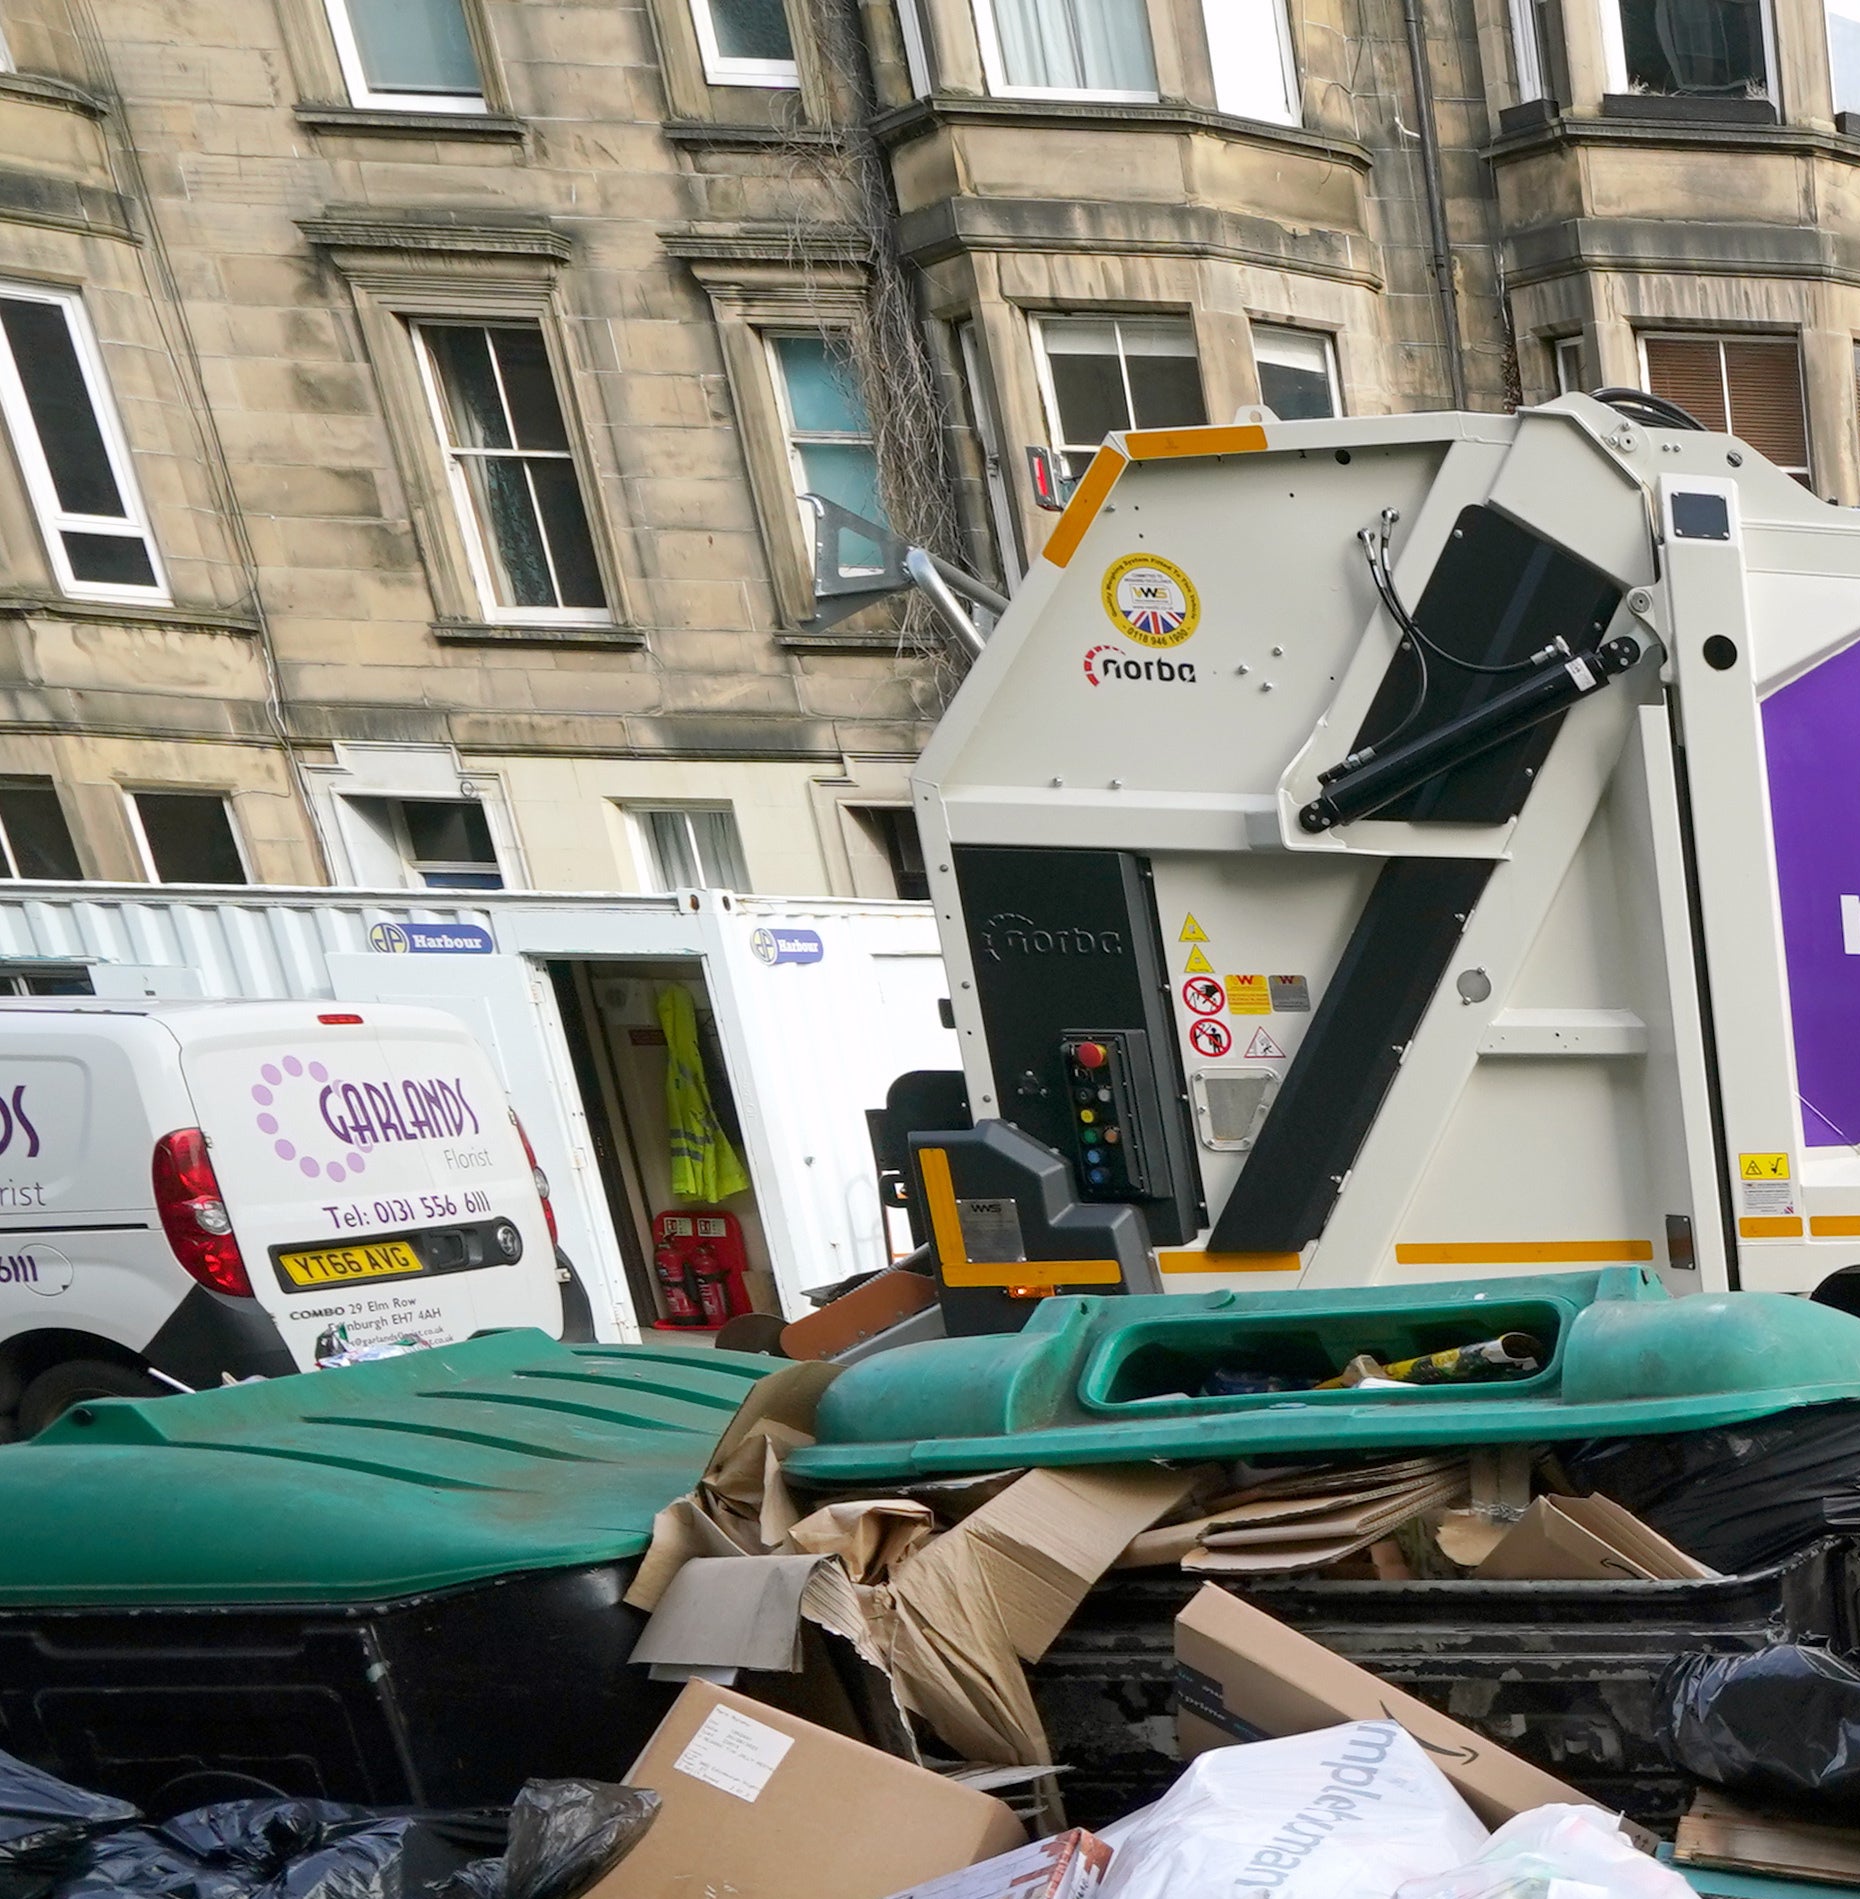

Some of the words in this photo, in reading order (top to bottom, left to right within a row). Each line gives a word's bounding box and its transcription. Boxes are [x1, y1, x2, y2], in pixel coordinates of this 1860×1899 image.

[1102, 657, 1196, 683] norba
[411, 933, 483, 950] Harbour
[777, 938, 818, 954] Harbour
[318, 1077, 481, 1145] GARLANDS
[443, 1147, 494, 1170] Florist
[322, 1203, 371, 1229] Tel:
[375, 1197, 416, 1224] 0131
[424, 1194, 458, 1218] 556
[465, 1190, 492, 1214] 6111
[293, 1253, 363, 1280] YT66
[369, 1245, 411, 1273] AVG
[289, 1307, 345, 1321] COMBO
[349, 1303, 363, 1315] 29
[368, 1301, 390, 1312] Elm
[392, 1297, 417, 1308] Row
[328, 1318, 389, 1334] Enburgh
[392, 1312, 414, 1325] EH7
[418, 1308, 442, 1320] 4AH
